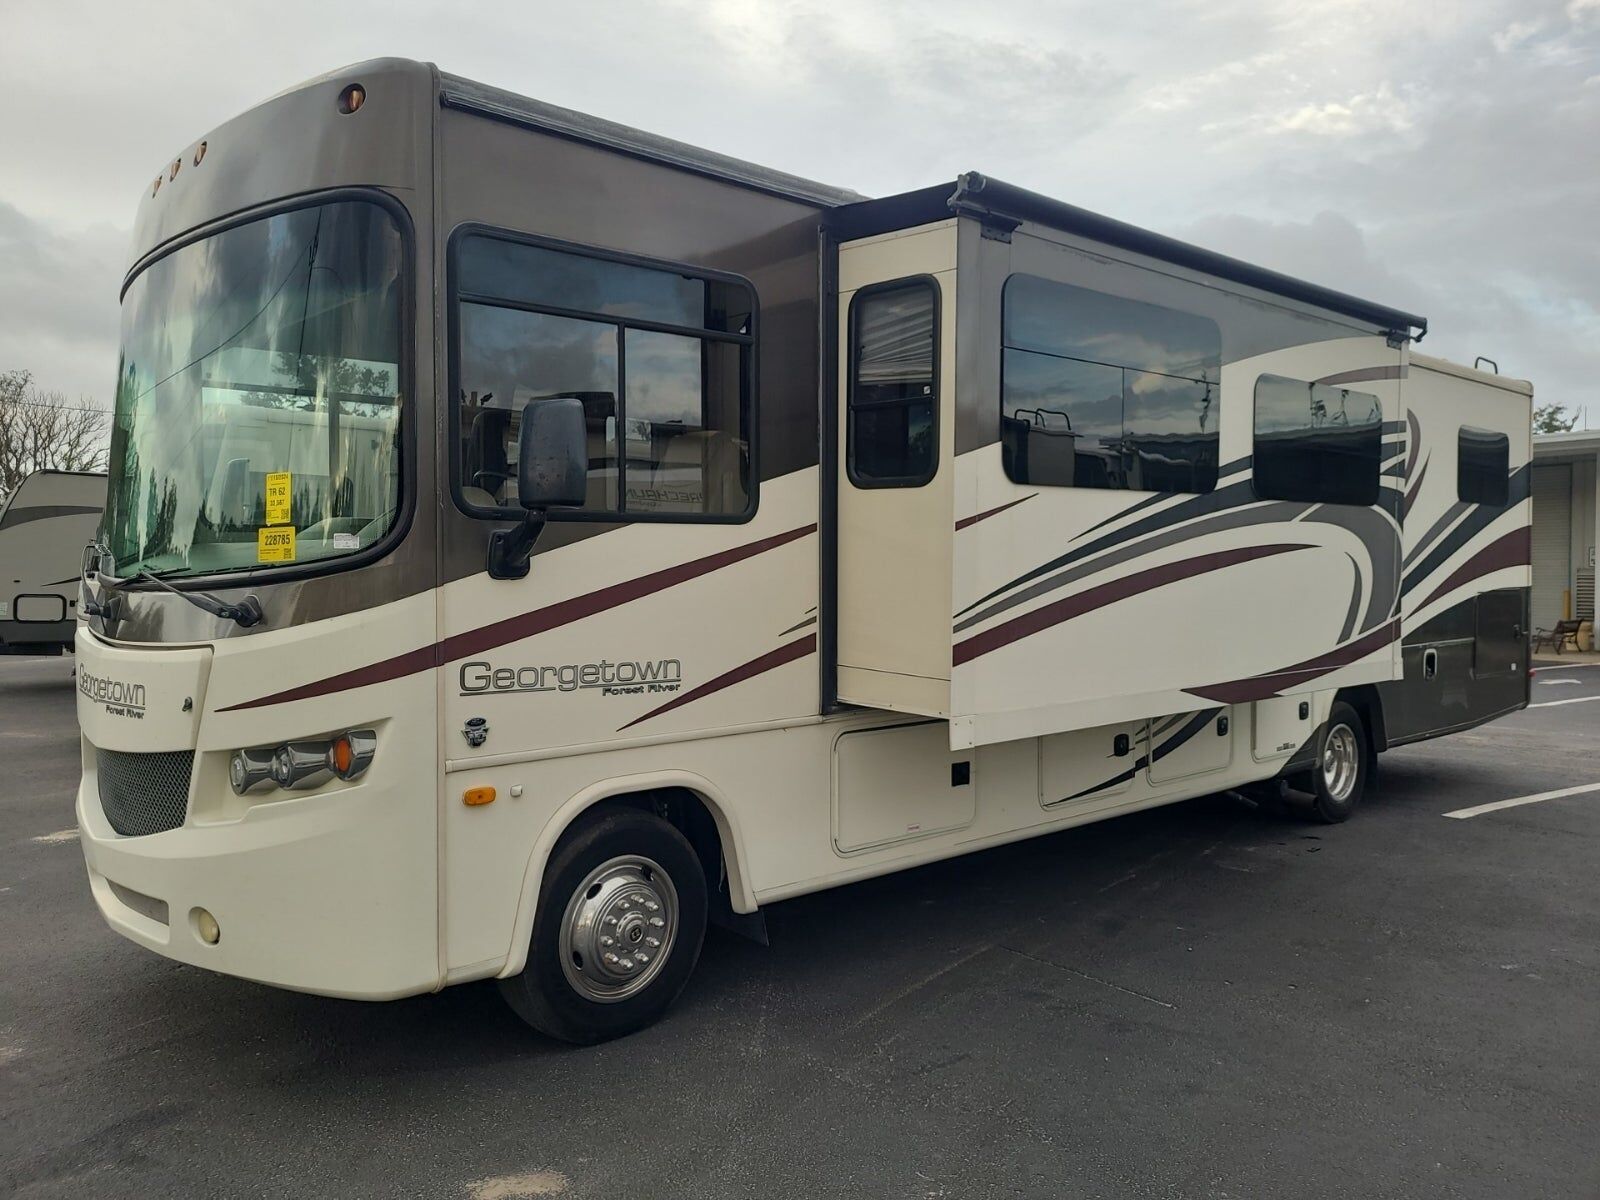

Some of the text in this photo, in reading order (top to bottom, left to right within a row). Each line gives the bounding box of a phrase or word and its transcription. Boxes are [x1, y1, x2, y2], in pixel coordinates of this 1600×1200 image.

[278, 486, 286, 496] 62
[264, 534, 291, 546] 228785
[459, 658, 682, 692] Georgetown
[79, 662, 146, 706] Georgetown
[602, 682, 681, 697] Forest River
[105, 704, 145, 720] Forest River
